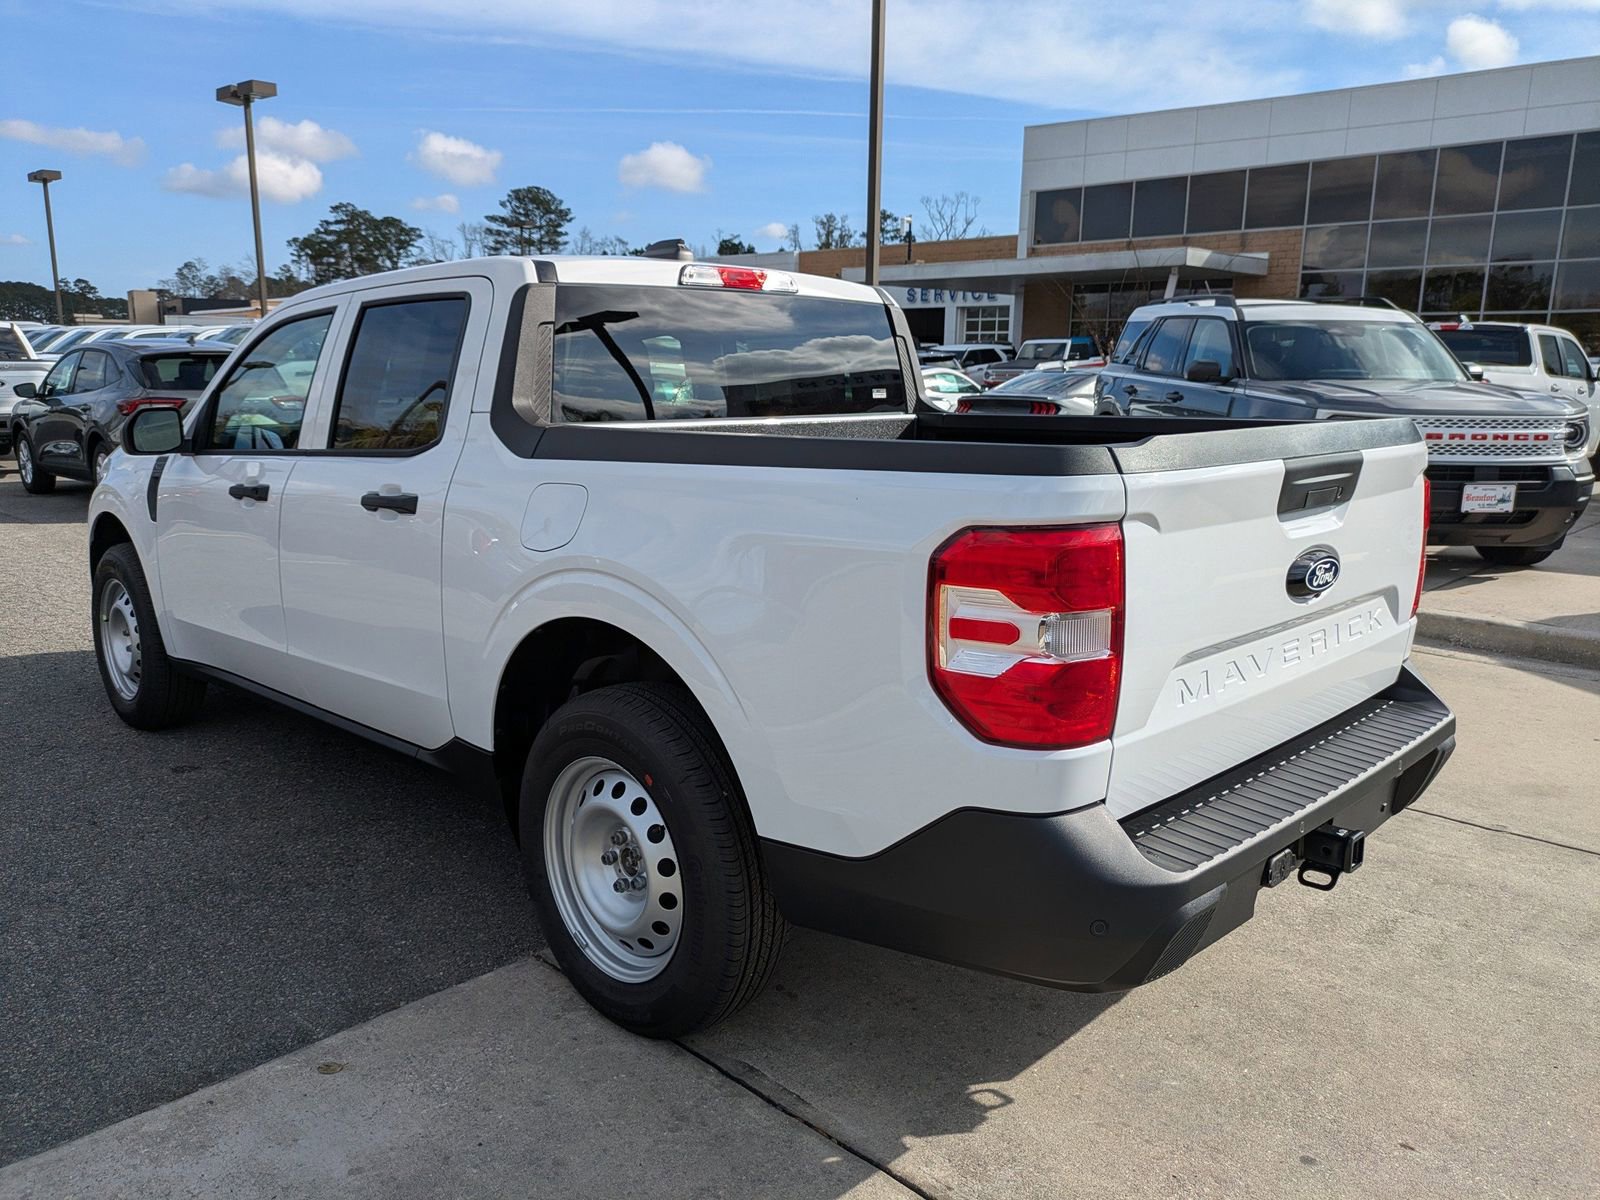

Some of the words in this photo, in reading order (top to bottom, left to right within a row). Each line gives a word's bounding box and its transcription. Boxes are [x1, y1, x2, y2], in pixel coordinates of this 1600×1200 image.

[906, 288, 997, 303] SERVICE
[1425, 433, 1549, 441] BRONCO
[1312, 562, 1336, 587] Ford
[1176, 607, 1384, 708] MAVERICK
